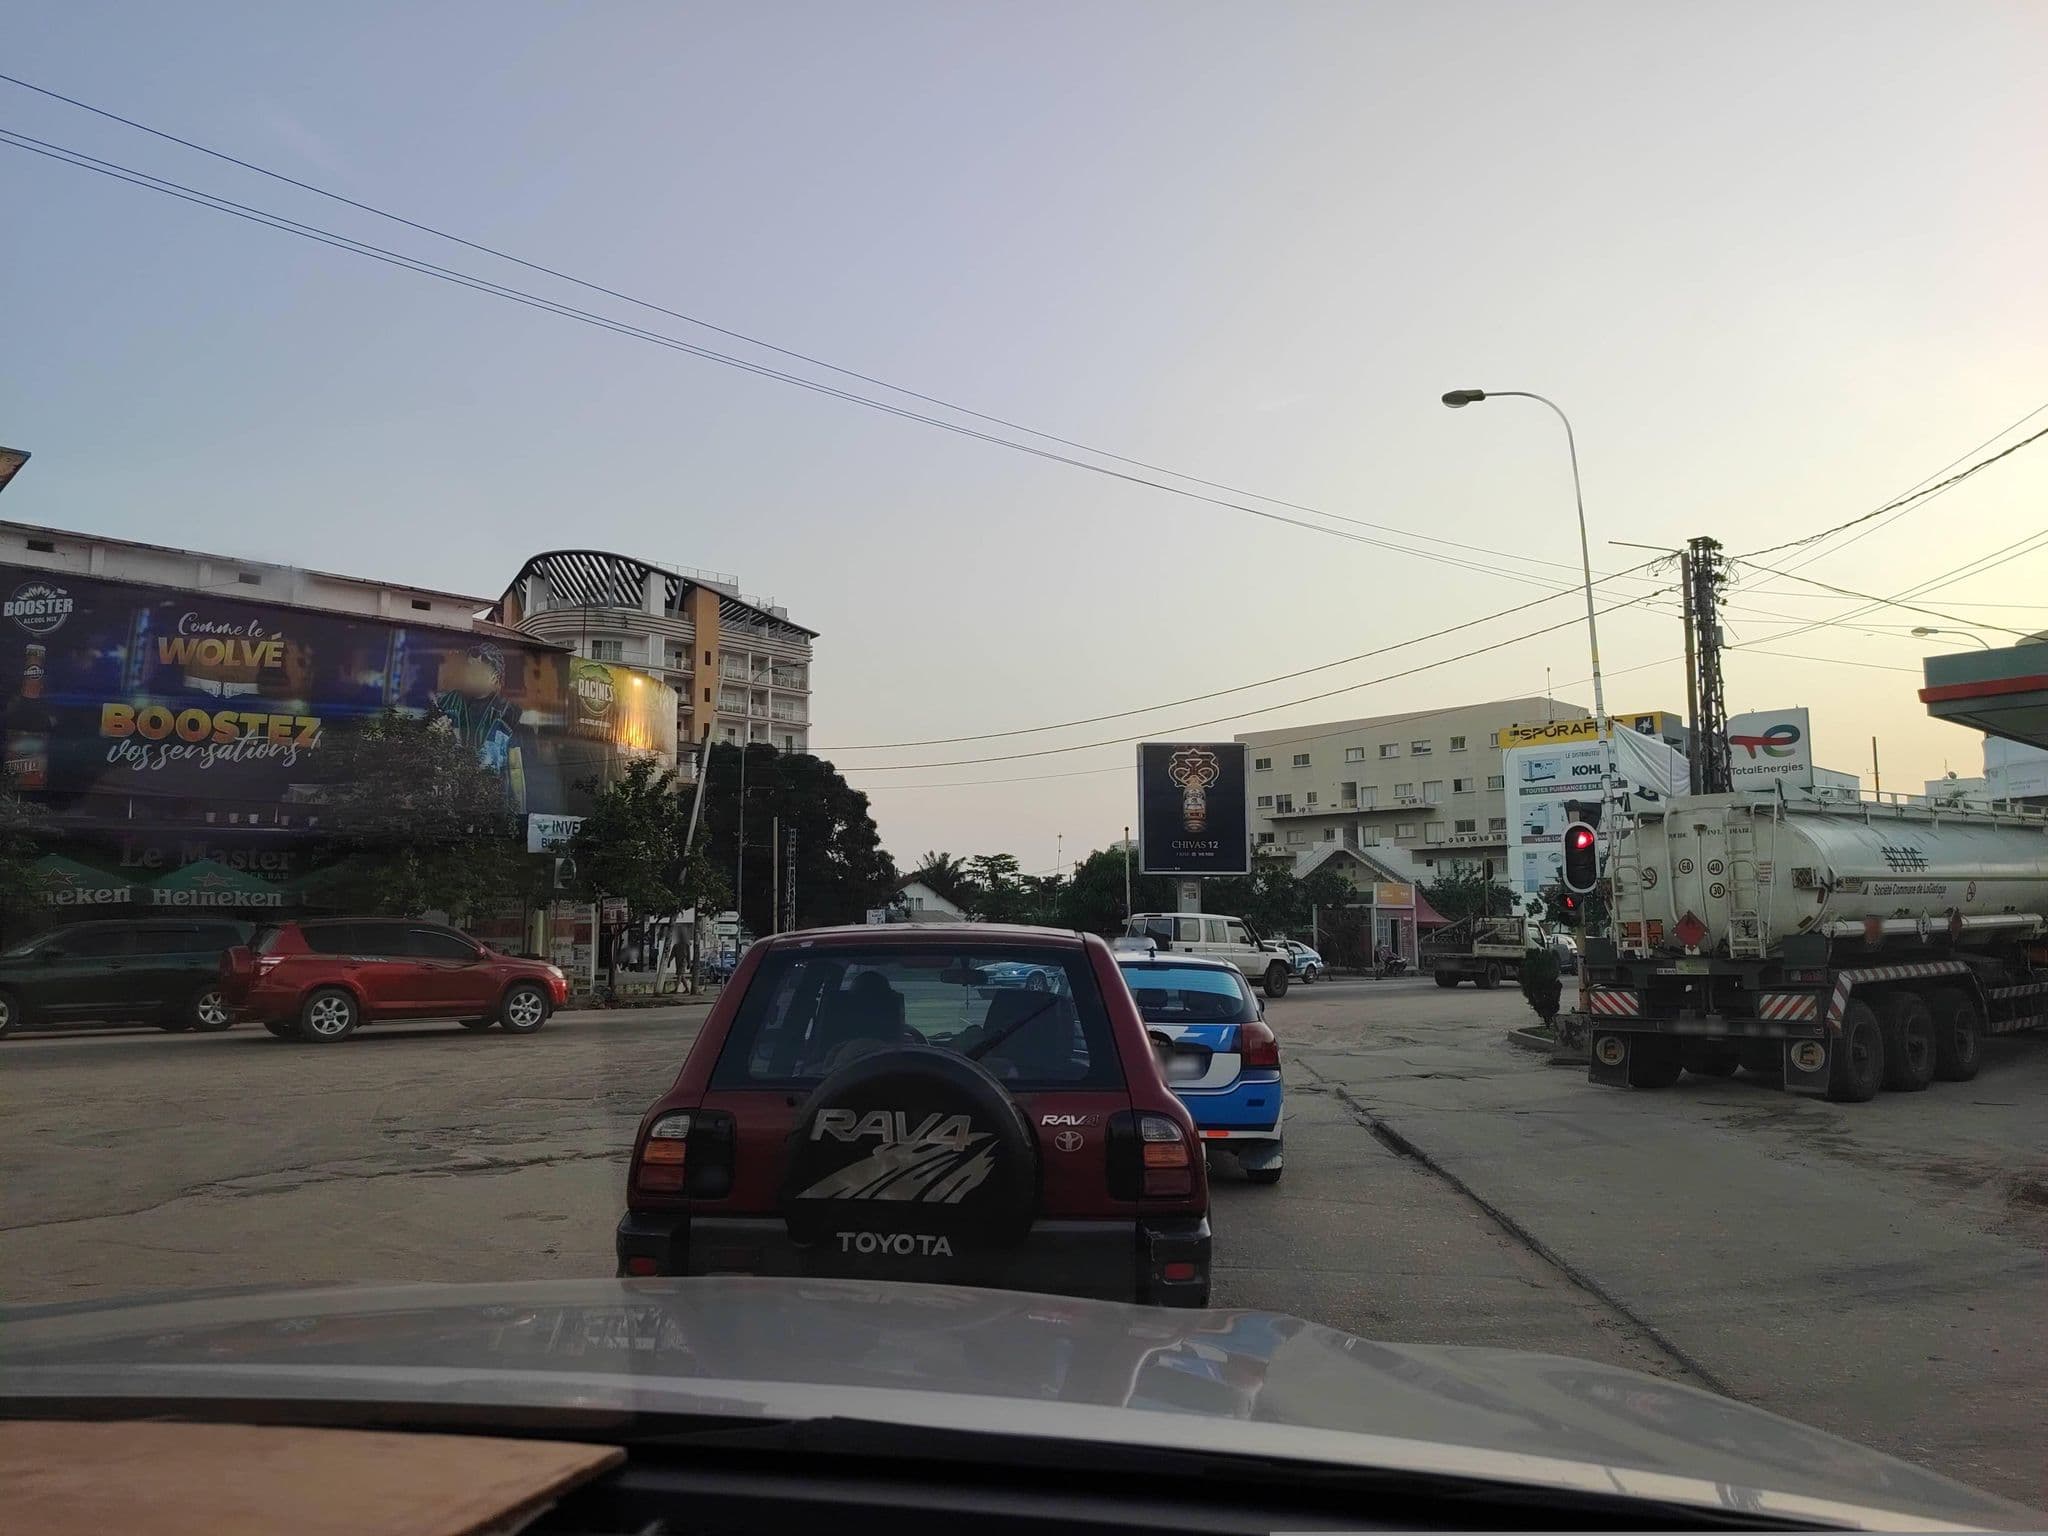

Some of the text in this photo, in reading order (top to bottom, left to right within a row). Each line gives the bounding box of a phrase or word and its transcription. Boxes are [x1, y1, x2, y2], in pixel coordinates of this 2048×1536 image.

[3, 598, 74, 617] BOOSTER
[178, 612, 266, 637] Comme le
[158, 632, 285, 669] WOLVÉ
[577, 678, 615, 703] RACINES
[102, 703, 322, 747] BOOSTEZ
[107, 739, 154, 771] vos
[1572, 762, 1618, 777] KOHLR
[1731, 763, 1804, 776] TotalEnergies
[1526, 786, 1549, 794] TOUTES
[1550, 784, 1587, 793] PUISSANCES
[1171, 840, 1219, 849] CHIVAS 12
[119, 846, 163, 868] Le
[1710, 863, 1720, 872] 40
[151, 886, 284, 906] Heineken
[1713, 886, 1722, 895] 30
[811, 1108, 973, 1152] RAV4
[836, 1231, 953, 1258] TOYOTA
